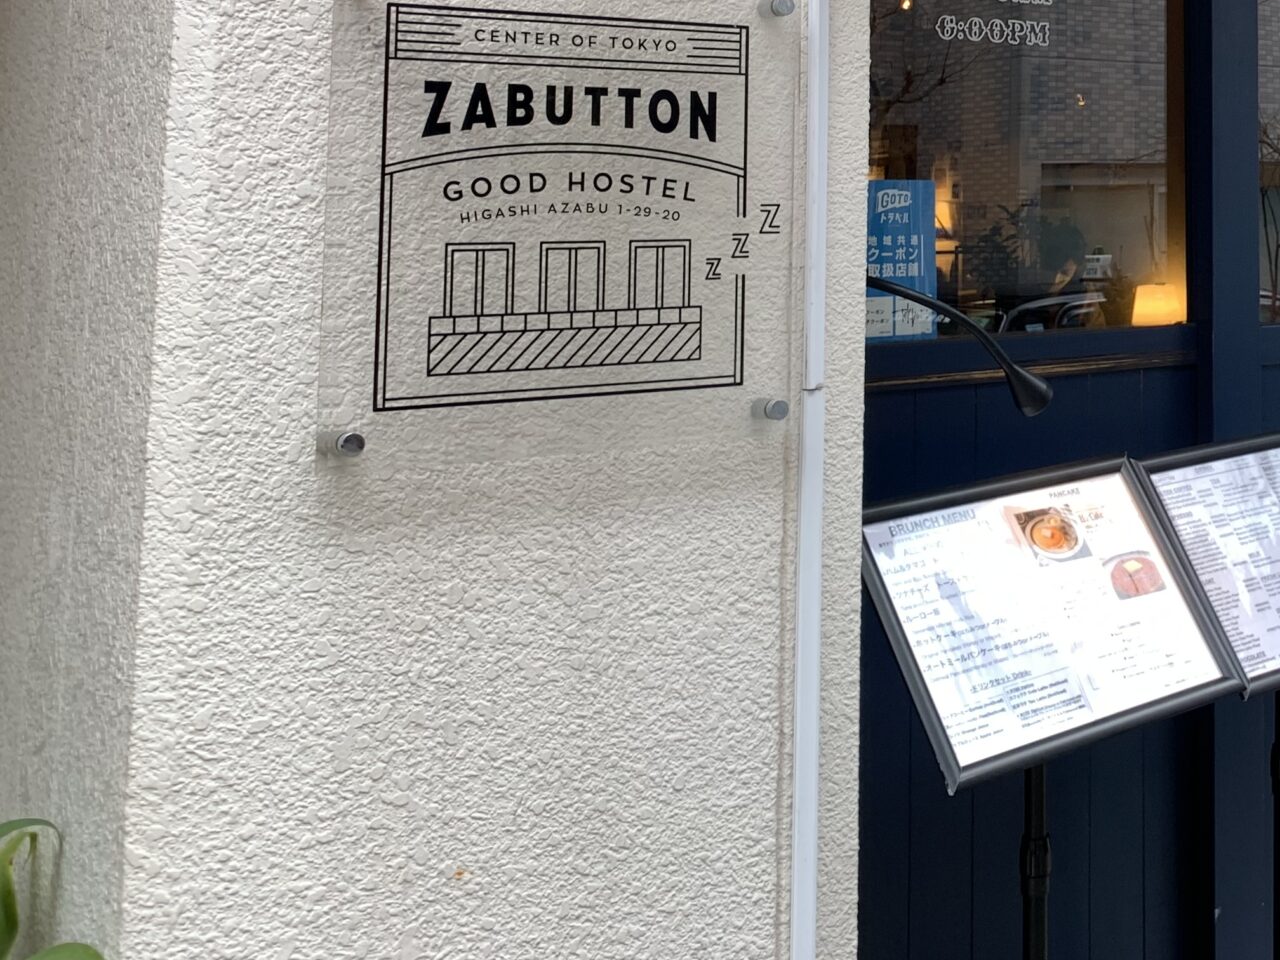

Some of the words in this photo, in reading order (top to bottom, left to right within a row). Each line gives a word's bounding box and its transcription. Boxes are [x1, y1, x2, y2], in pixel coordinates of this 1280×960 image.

[474, 28, 560, 48] CENTER
[571, 34, 599, 49] OF
[609, 36, 678, 53] TOKYO
[935, 15, 1050, 46] 6:00PM
[421, 80, 719, 143] ZABUTTON
[443, 173, 547, 202] GOOD
[568, 171, 697, 203] HOSTEL
[460, 203, 538, 224] HIGASHI
[547, 202, 609, 216] AZABU
[617, 204, 682, 222] 1-29-20
[868, 247, 918, 261] クーポン
[887, 515, 940, 538] BRUNCH
[940, 508, 976, 528] MENU
